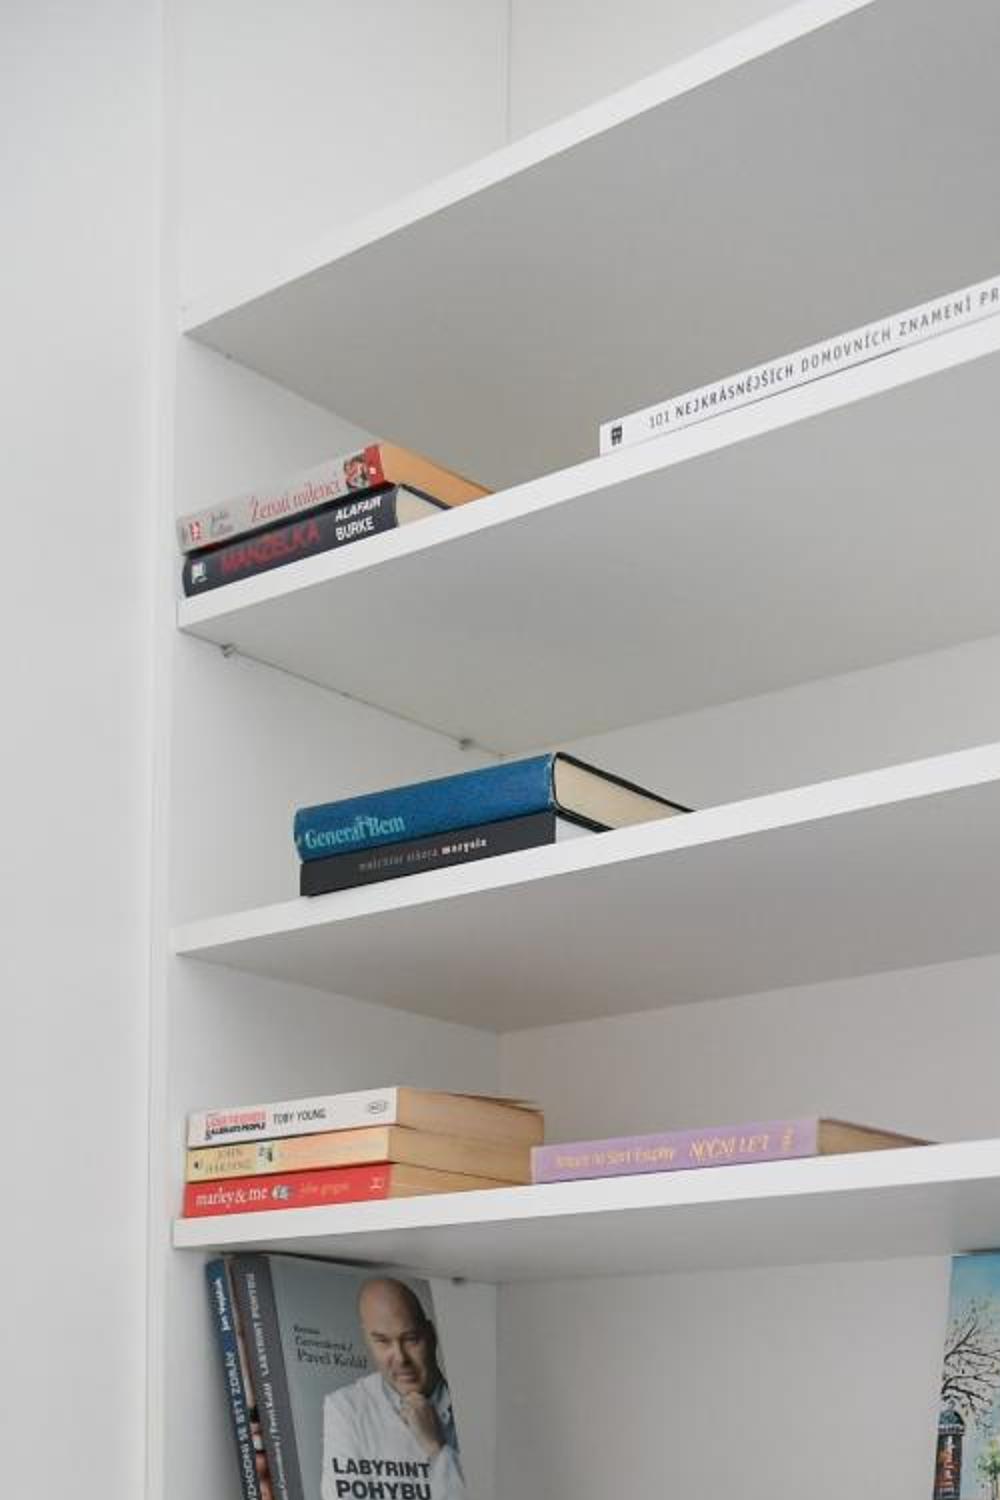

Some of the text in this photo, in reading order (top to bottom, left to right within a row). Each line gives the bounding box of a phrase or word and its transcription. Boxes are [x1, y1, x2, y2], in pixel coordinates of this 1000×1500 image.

[650, 410, 670, 429] 101
[801, 326, 891, 372] DOMOVNÍCH
[899, 295, 972, 337] ZNAMENÍ
[335, 516, 375, 541] BURKE
[273, 1112, 294, 1125] TOBY
[297, 1107, 326, 1121] YOUNG
[333, 1457, 431, 1479] LABYRINT
